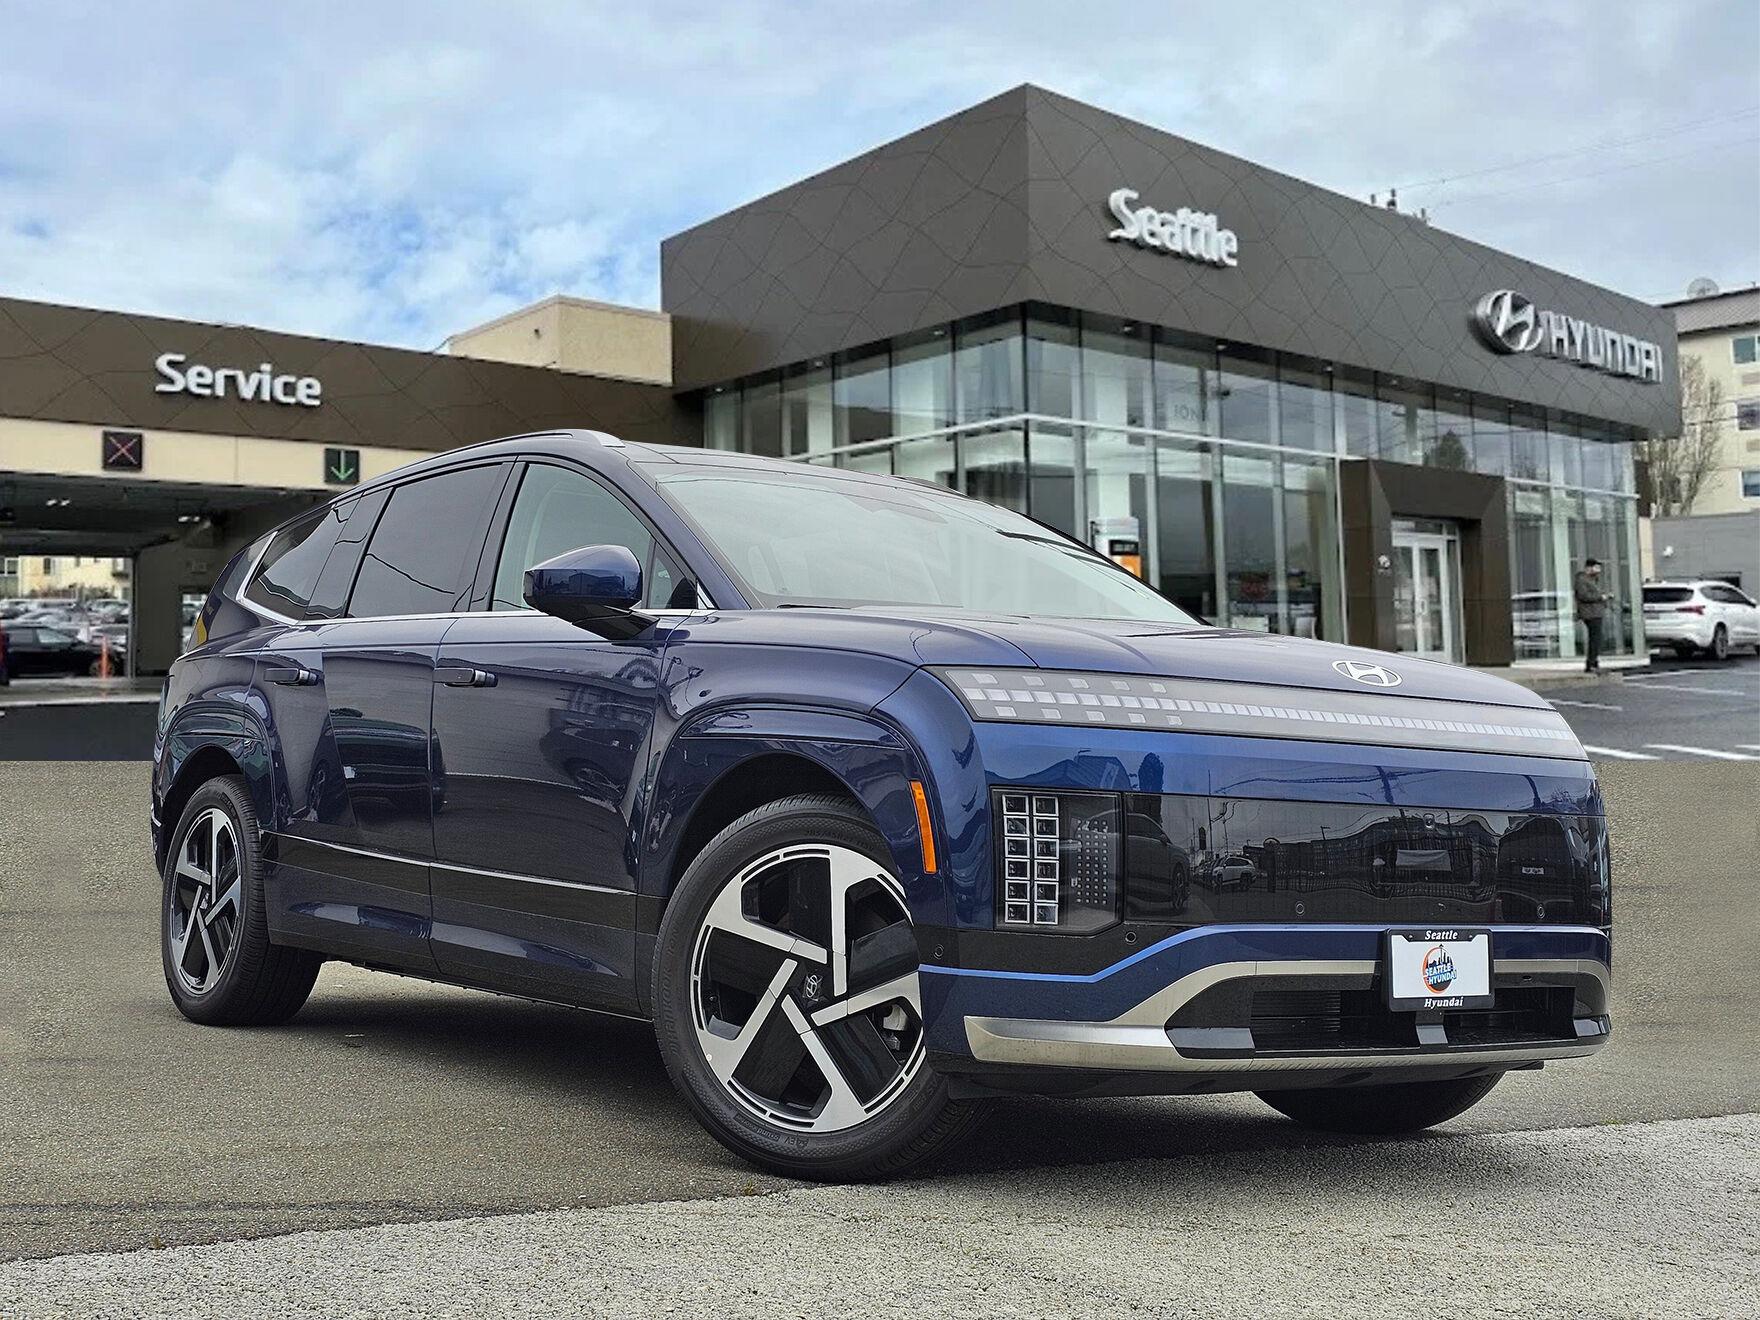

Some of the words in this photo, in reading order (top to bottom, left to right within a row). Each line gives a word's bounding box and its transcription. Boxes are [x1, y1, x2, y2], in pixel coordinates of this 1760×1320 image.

[1109, 188, 1238, 267] Seattle
[1540, 311, 1663, 383] HYUNDAI
[155, 353, 322, 406] Service
[1424, 930, 1458, 940] Seattle
[1425, 962, 1452, 977] SEATTLE
[1428, 970, 1457, 985] HYUNDAI
[1424, 997, 1464, 1009] Hyundai
